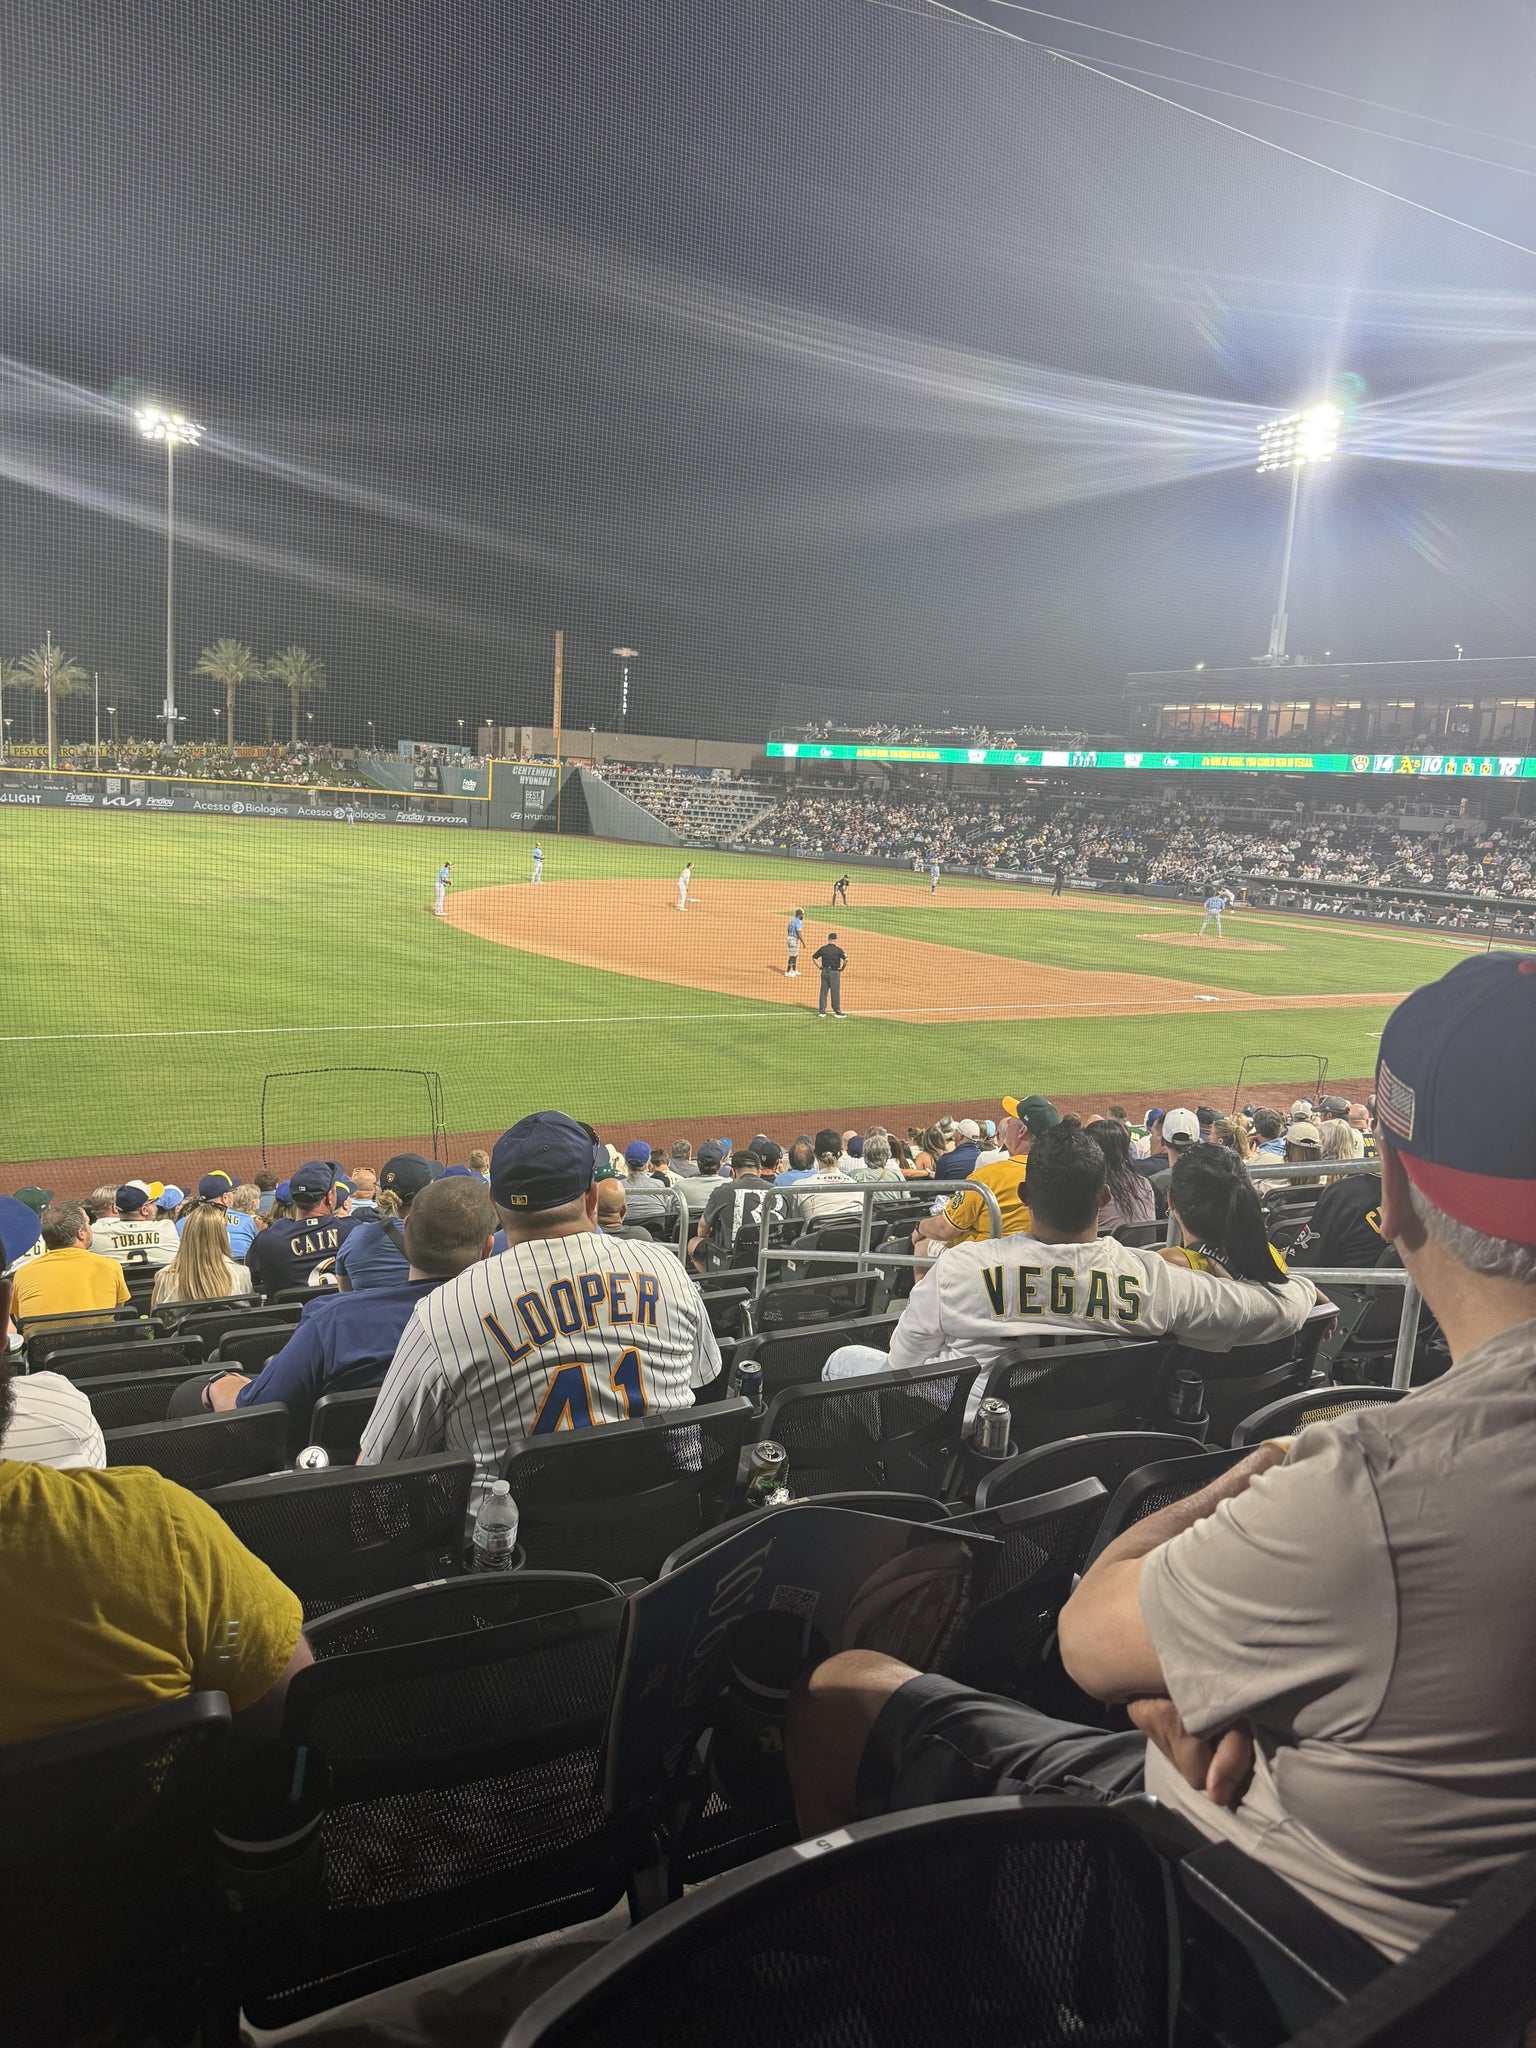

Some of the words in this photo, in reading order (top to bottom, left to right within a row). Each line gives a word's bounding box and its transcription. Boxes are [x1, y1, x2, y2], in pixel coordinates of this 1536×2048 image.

[14, 747, 34, 756] PEST
[36, 747, 80, 756] COTROL
[512, 765, 557, 778] CENTENNIAL
[1375, 757, 1394, 771] 14
[1422, 758, 1442, 772] 10
[519, 776, 551, 786] HYUNDAI
[8, 793, 42, 804] LIGHT
[65, 792, 95, 802] Findlay
[145, 796, 175, 807] Findlay
[193, 800, 231, 811] Acesso
[245, 803, 289, 816] Biologics
[297, 806, 332, 817] Acesso
[350, 809, 387, 822] iologics
[396, 811, 425, 823] Findlay
[426, 815, 468, 824] TOYOTA
[524, 813, 557, 822] HYUNDAI
[112, 1233, 160, 1249] TURANG
[291, 1228, 339, 1257] CAIN
[307, 1256, 339, 1287] 6
[981, 1264, 1140, 1323] VEGAS
[482, 1272, 661, 1365] LOOPER
[527, 1347, 649, 1438] 41
